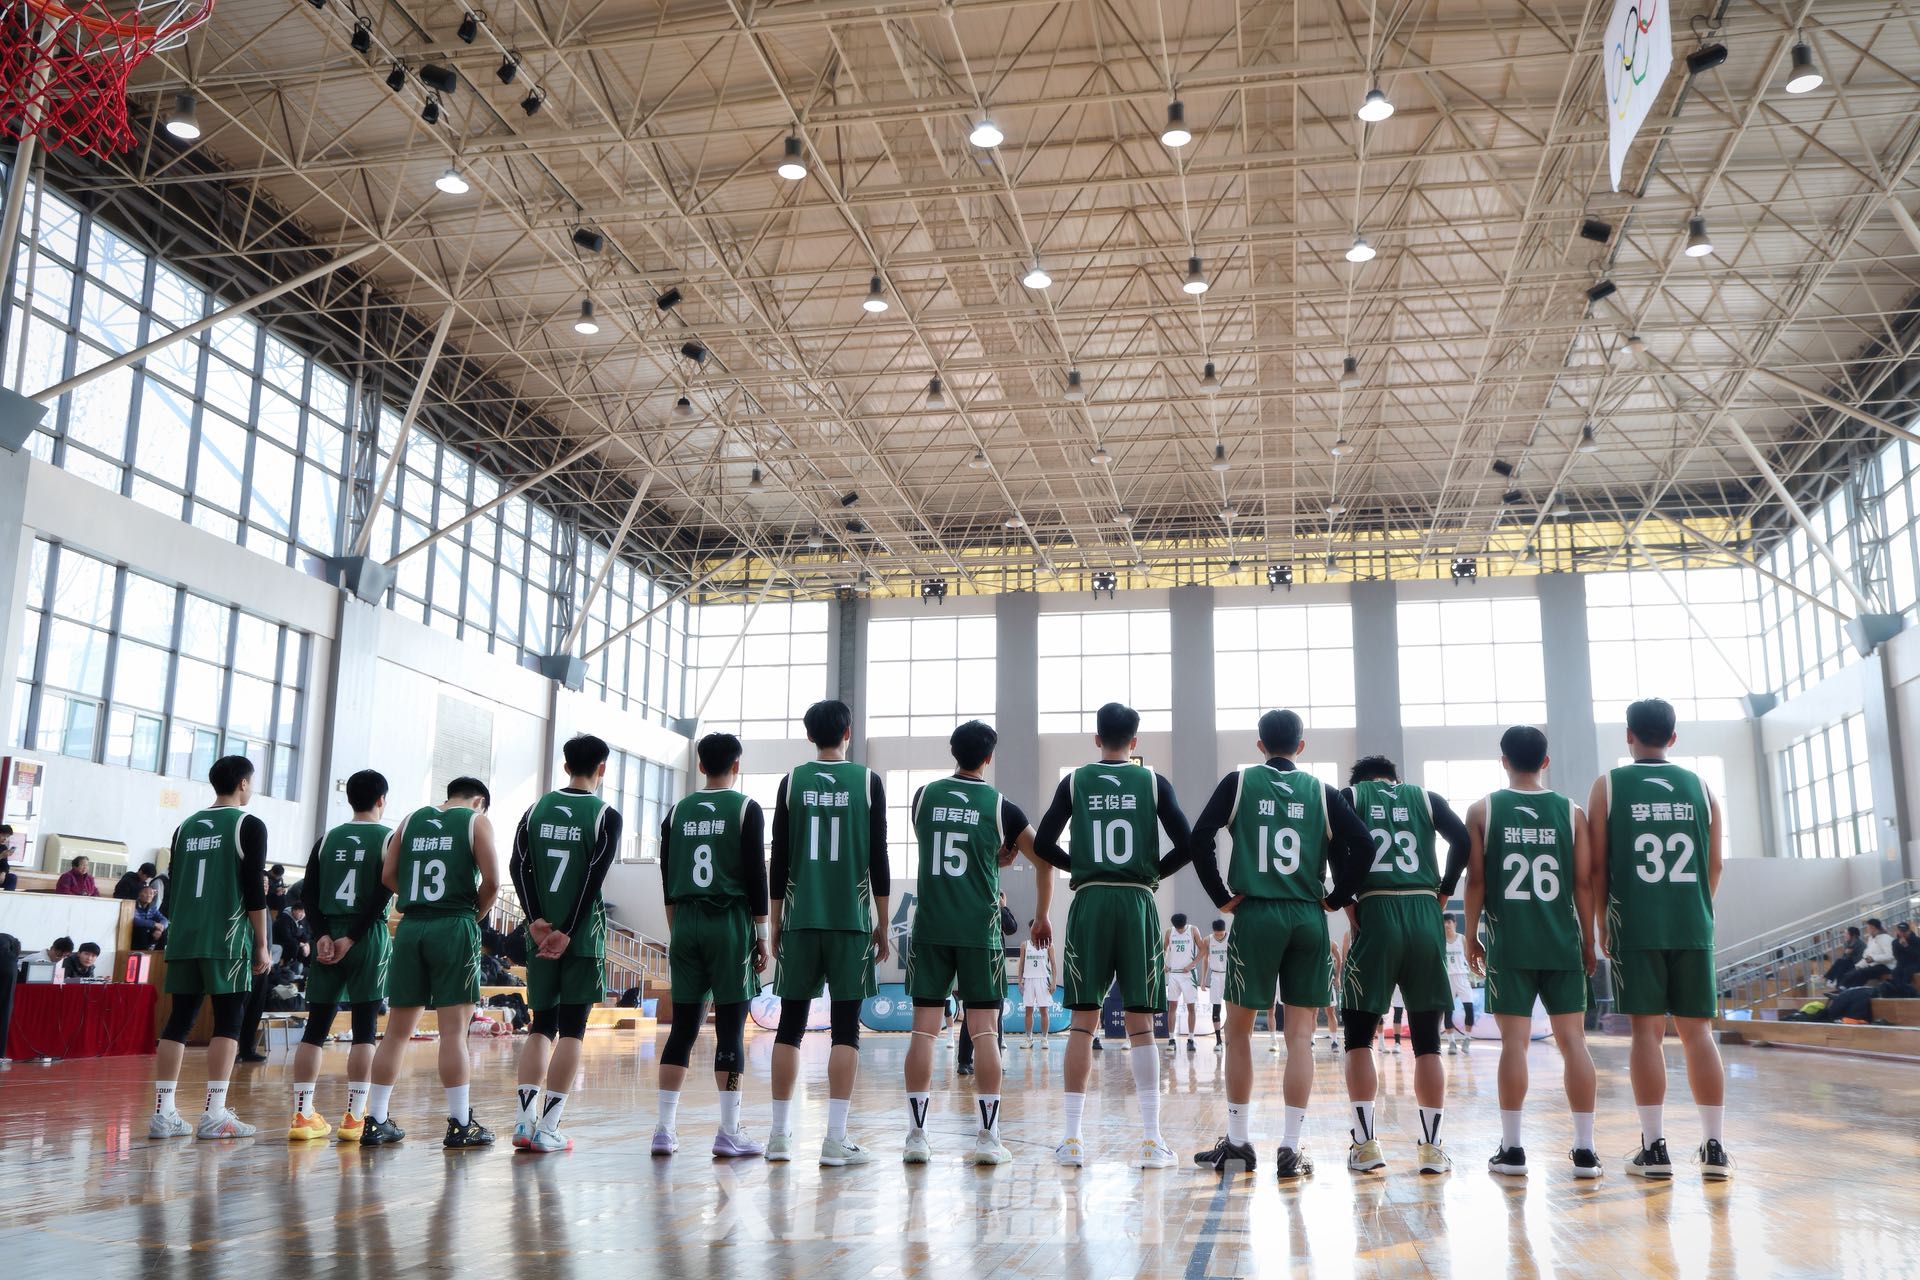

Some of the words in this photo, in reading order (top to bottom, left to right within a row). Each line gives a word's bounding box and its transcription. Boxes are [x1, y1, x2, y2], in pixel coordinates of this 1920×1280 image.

[683, 820, 726, 836] 徐鑫博
[1258, 799, 1304, 820] 刘源
[1370, 805, 1409, 822] 马腾
[810, 816, 840, 862] 11
[931, 831, 969, 877] 15
[1092, 818, 1134, 865] 10
[1258, 825, 1301, 876] 19
[1369, 828, 1420, 874] 23
[1634, 832, 1698, 884] 32
[195, 858, 207, 898] 1
[335, 868, 357, 907] 4
[409, 858, 447, 902] 13
[546, 848, 571, 893] 7
[692, 844, 714, 888] 8
[1502, 852, 1560, 902] 26
[1033, 960, 1038, 968] 3
[1176, 944, 1185, 953] 26
